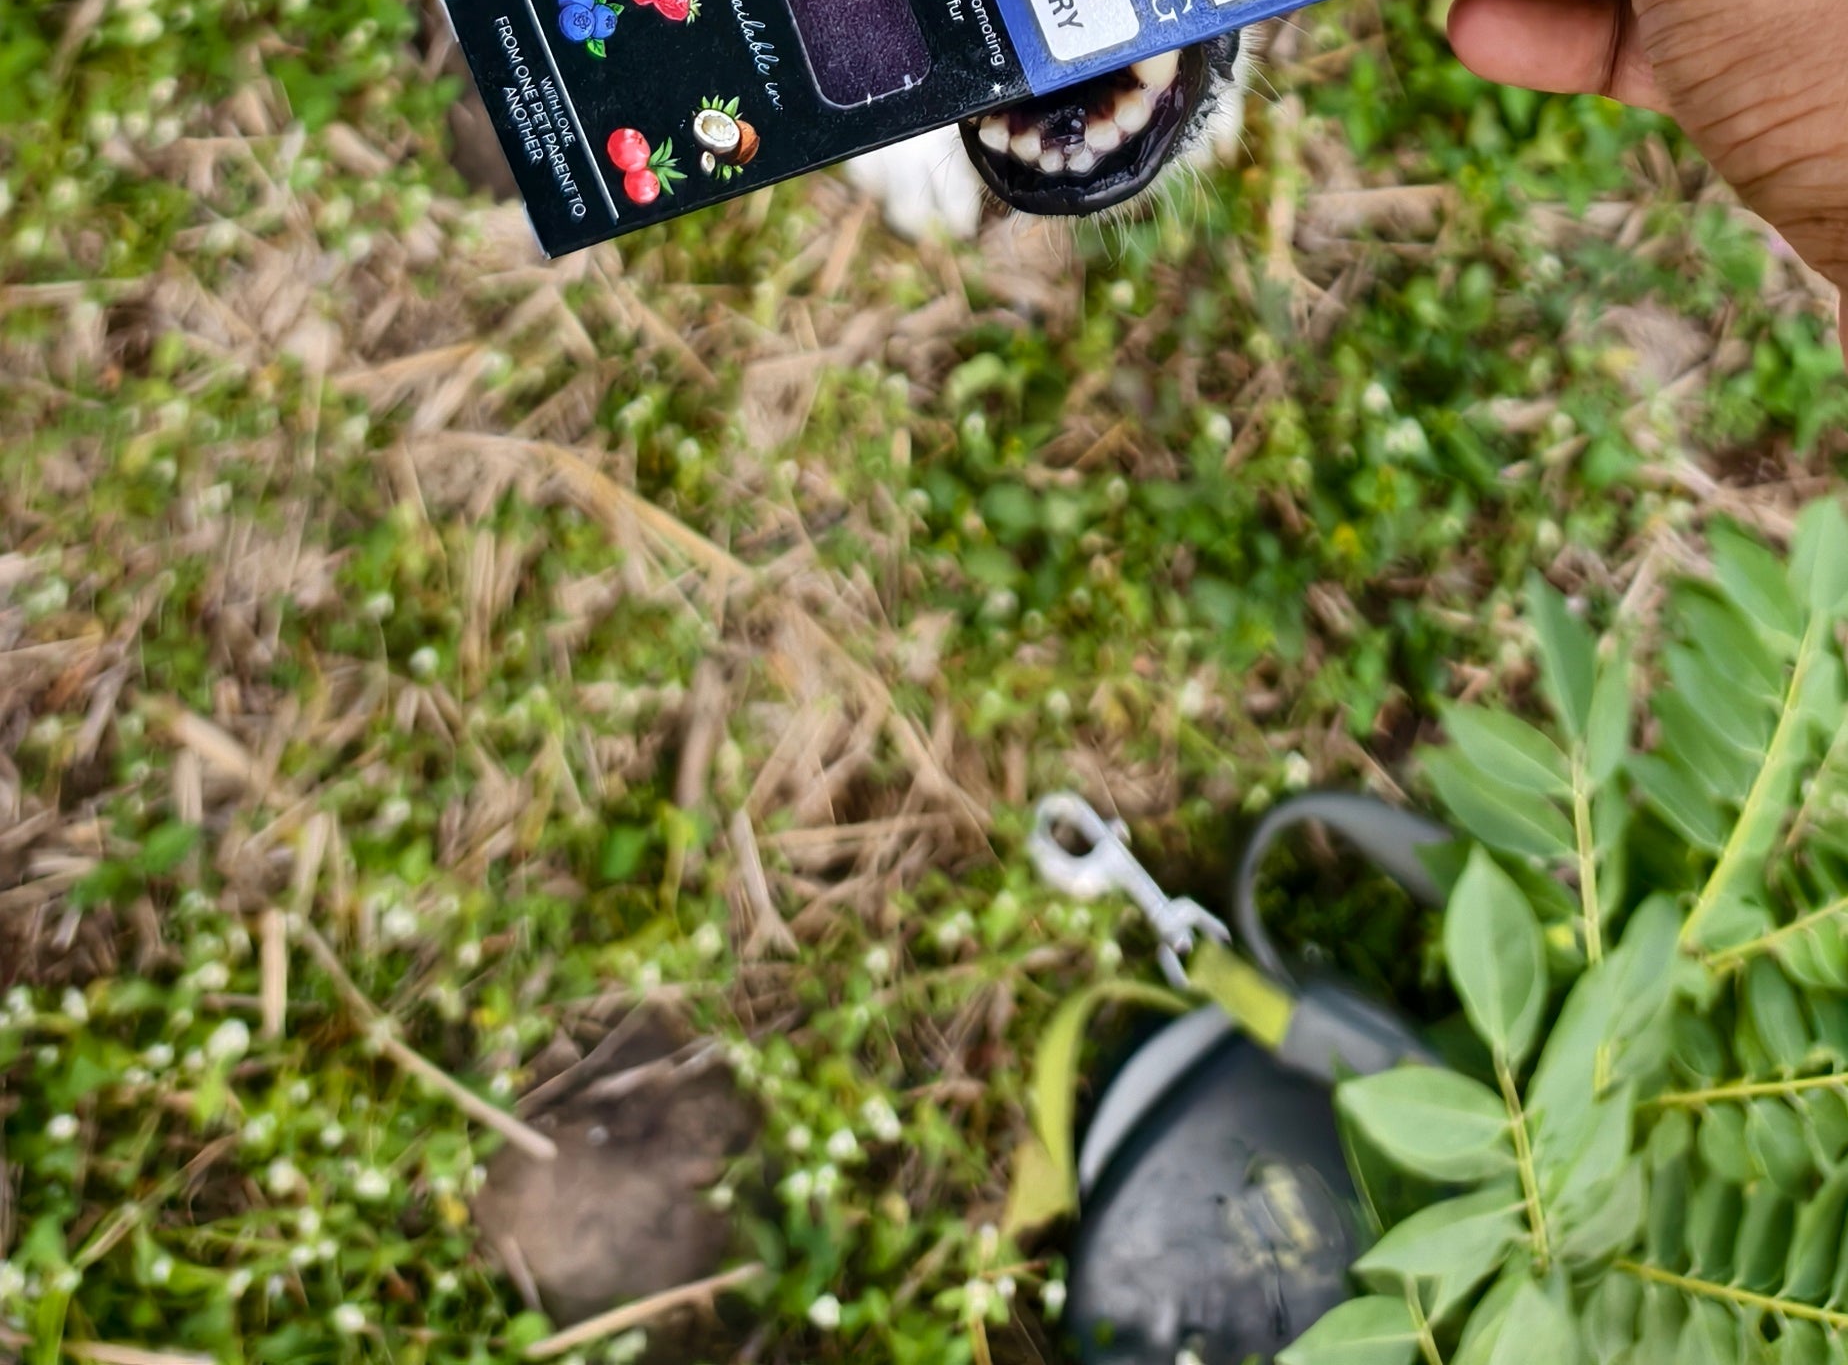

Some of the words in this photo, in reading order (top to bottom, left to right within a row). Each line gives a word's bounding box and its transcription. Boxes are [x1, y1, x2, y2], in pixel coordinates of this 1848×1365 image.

[947, 0, 964, 21] fur
[496, 16, 523, 63] FROM
[516, 66, 539, 100] ONE
[530, 102, 552, 129] PET
[543, 133, 578, 192] PARENT
[569, 195, 586, 216] TO
[504, 88, 543, 160] ANOTHER
[541, 77, 561, 110] WITH
[554, 111, 575, 147] LOVE,
